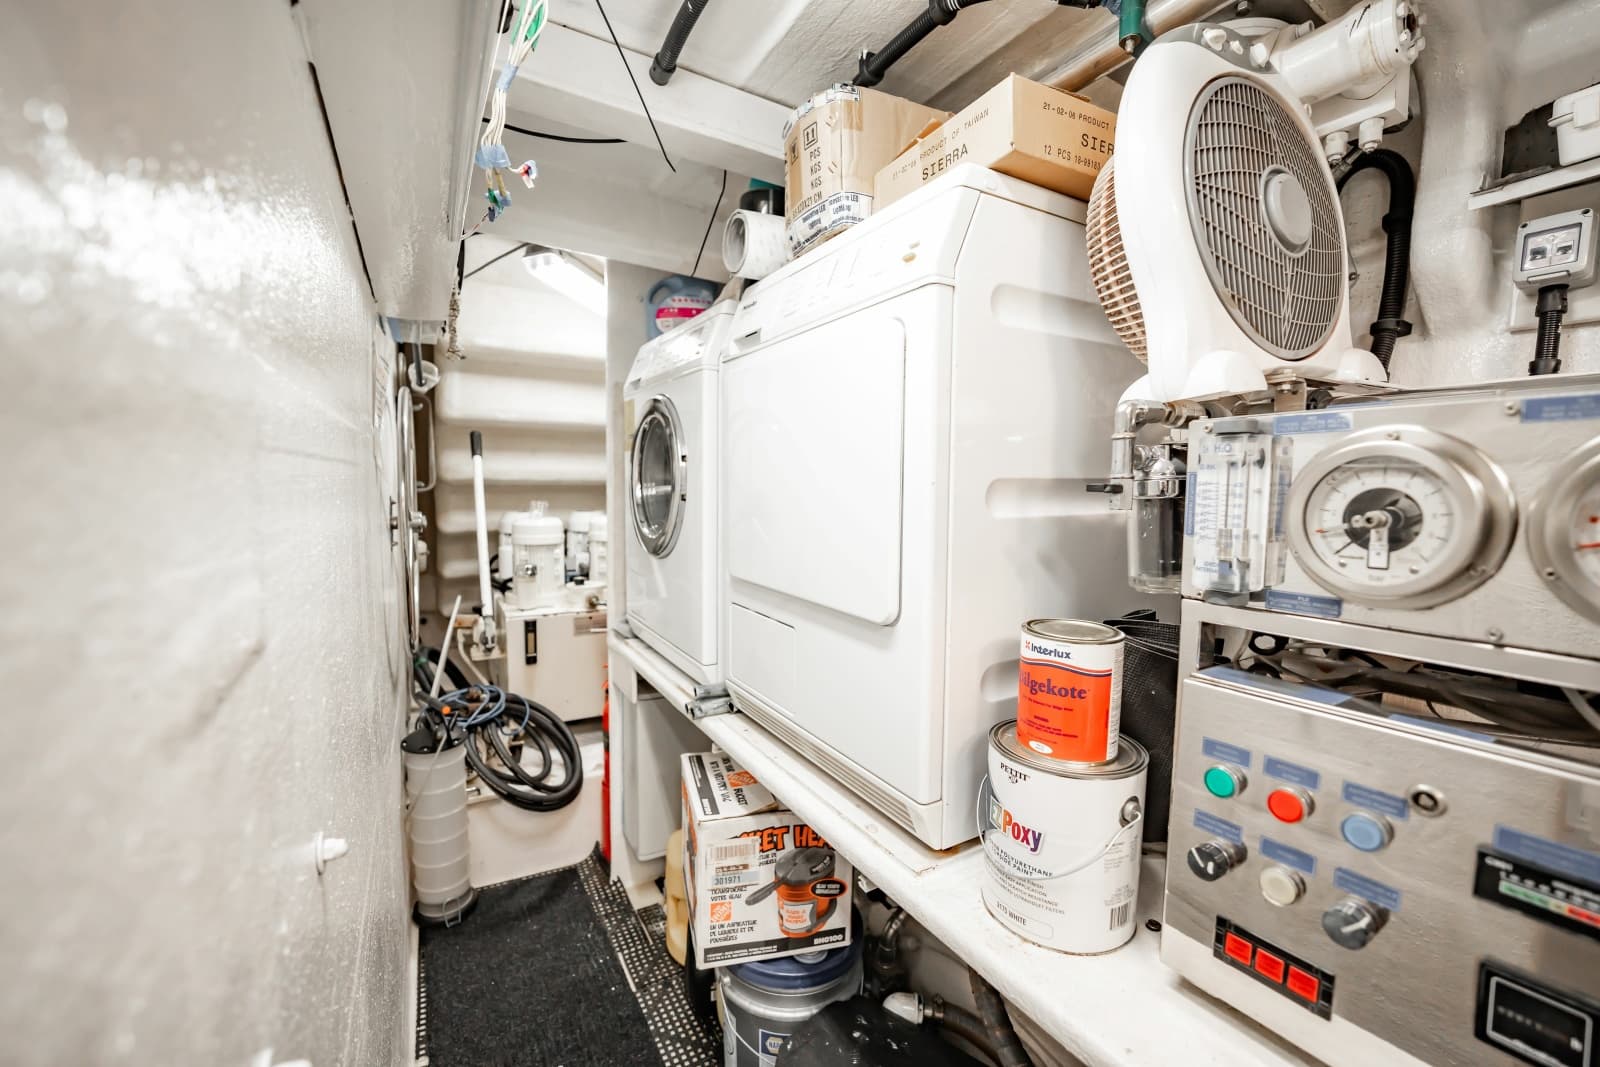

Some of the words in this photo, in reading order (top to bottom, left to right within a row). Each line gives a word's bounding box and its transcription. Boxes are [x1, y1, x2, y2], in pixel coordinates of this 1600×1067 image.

[964, 108, 989, 129] TAIWAN
[1078, 113, 1110, 130] PRODUCT
[810, 146, 821, 160] PCS
[1044, 144, 1052, 156] 12
[1058, 148, 1071, 161] PCS
[1081, 133, 1114, 156] SIER
[810, 161, 822, 177] KGS
[922, 143, 968, 181] SIERRA
[1031, 642, 1072, 660] Interlux
[1000, 762, 1028, 782] PETTIT
[1012, 863, 1034, 877] PAINT
[714, 876, 741, 886] 301971
[1008, 910, 1027, 926] WHITE
